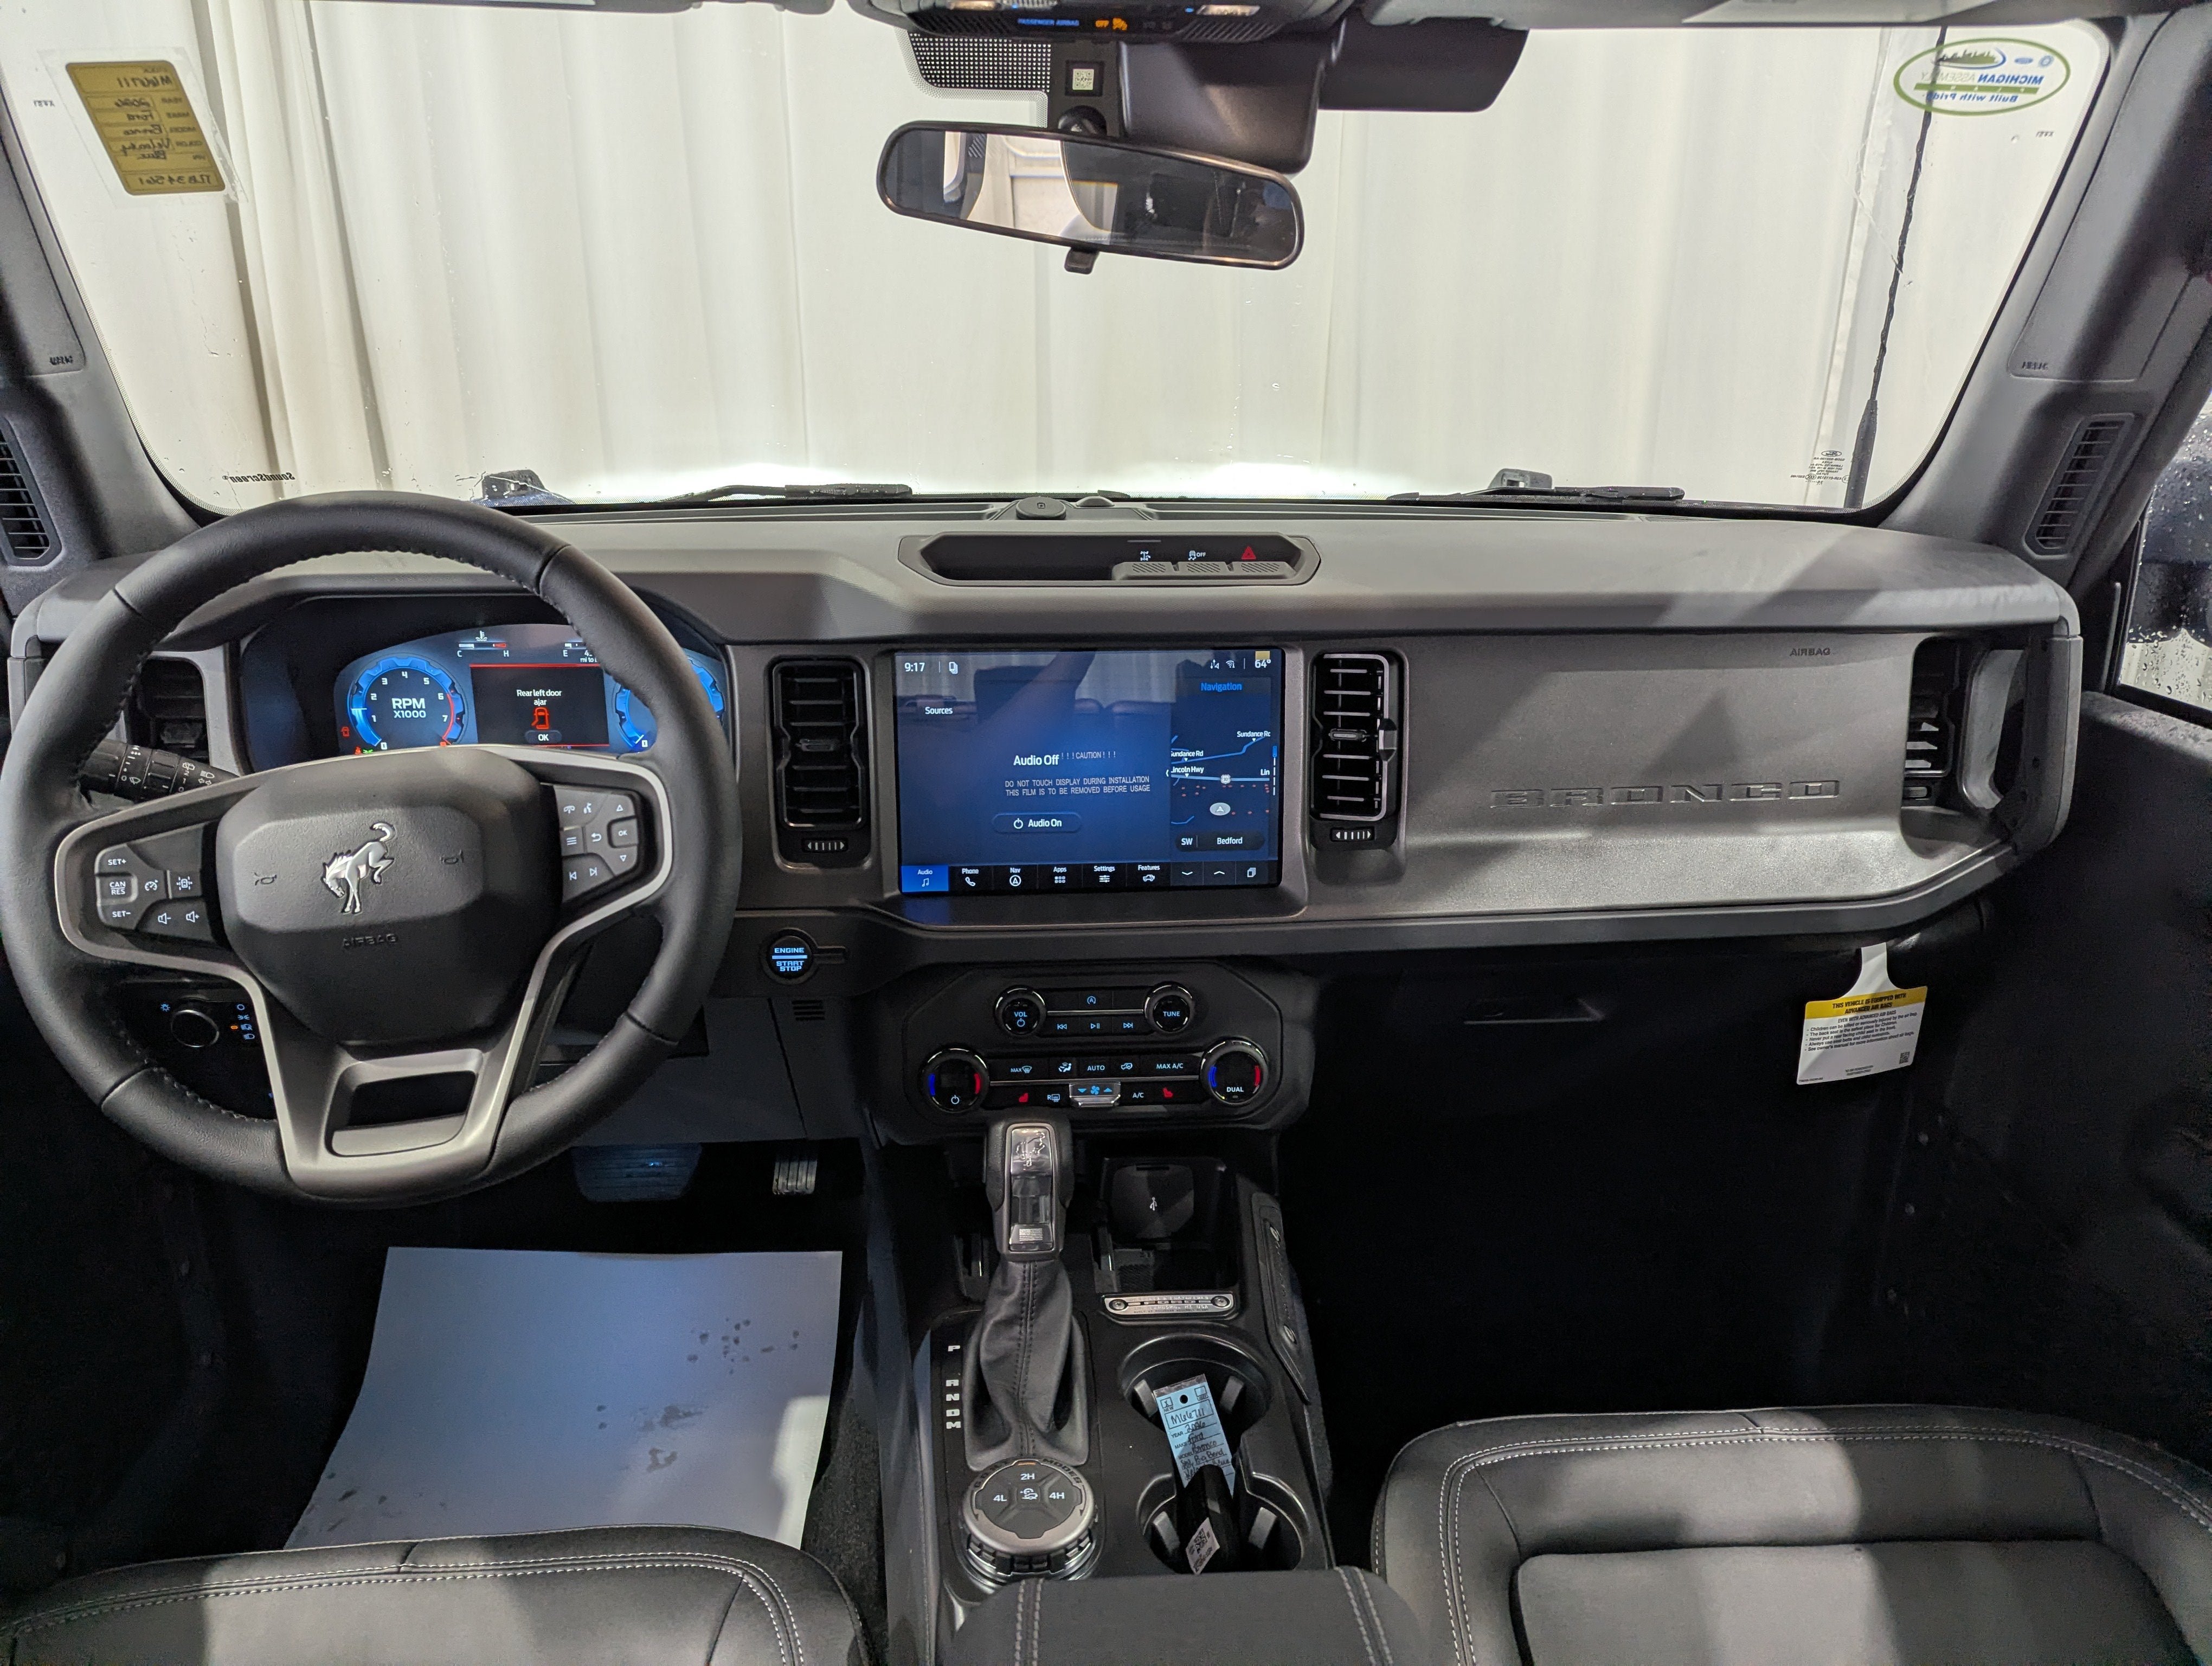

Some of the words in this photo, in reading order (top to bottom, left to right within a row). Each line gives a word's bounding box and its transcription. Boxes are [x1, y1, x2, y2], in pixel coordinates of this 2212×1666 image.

[1017, 18, 1054, 26] PASSENGER
[1789, 647, 1831, 656] AIRBAG
[904, 662, 925, 672] 9:17
[1255, 659, 1271, 668] 64°
[1201, 682, 1242, 692] Navigation
[391, 698, 426, 709] RPM
[394, 710, 426, 719] X1000
[1013, 755, 1042, 766] Audio
[1044, 754, 1059, 765] Off
[1191, 766, 1204, 774] Hwy
[1109, 776, 1150, 784] INSTALLATION
[1130, 784, 1150, 792] USAGE
[1490, 780, 1840, 808] BRONCO
[1028, 819, 1050, 827] Audio
[1871, 995, 1893, 1003] EQUIPPED
[1844, 1005, 1870, 1014] ADVANCED
[1171, 1408, 1205, 1424] M66711
[1043, 1458, 1083, 1484] MODES
